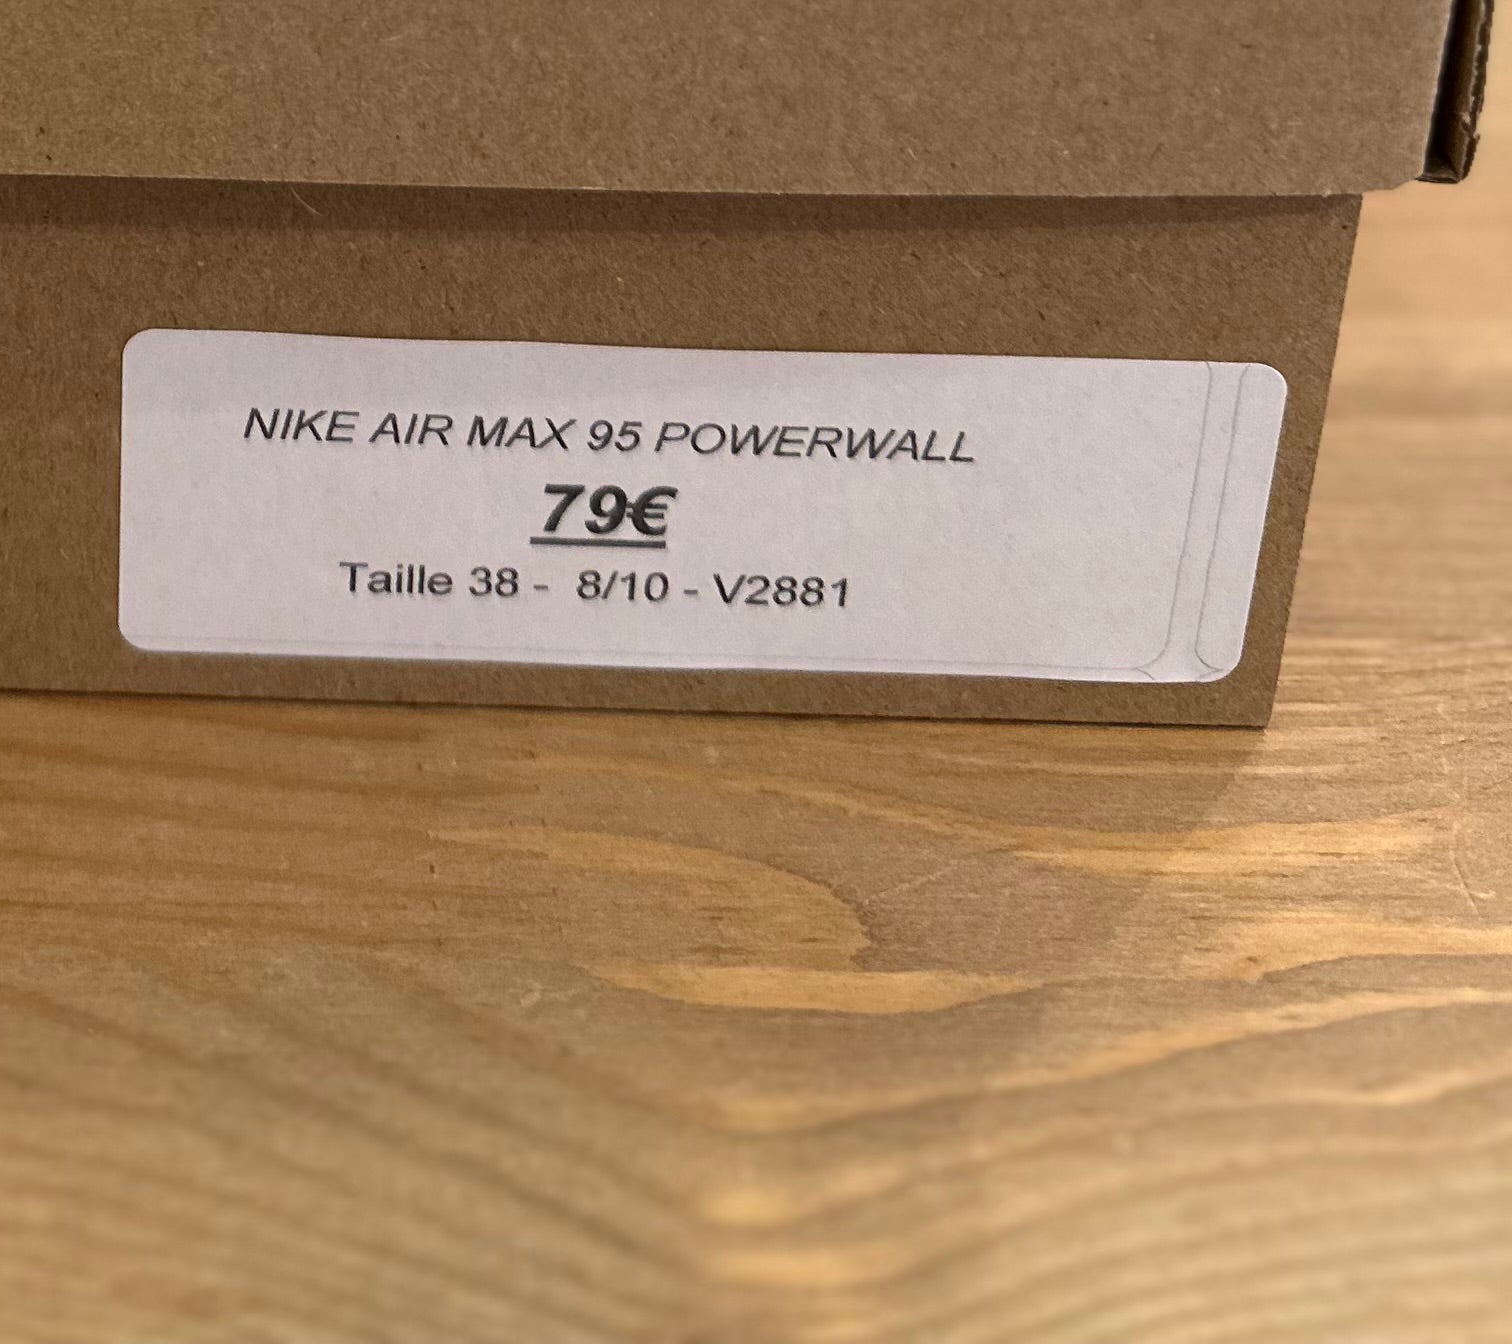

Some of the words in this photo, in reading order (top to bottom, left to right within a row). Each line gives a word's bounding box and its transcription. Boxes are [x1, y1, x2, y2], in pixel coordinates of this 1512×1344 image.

[244, 407, 360, 444] NIKE
[368, 412, 454, 448] AIR
[466, 414, 577, 452] MAX
[586, 419, 643, 454] 95
[653, 421, 976, 465] POWERWALL
[542, 483, 679, 540] 79€
[338, 561, 454, 597] Taille
[468, 565, 520, 599] 38
[576, 569, 670, 604] 8/10
[713, 572, 849, 609] V2881
